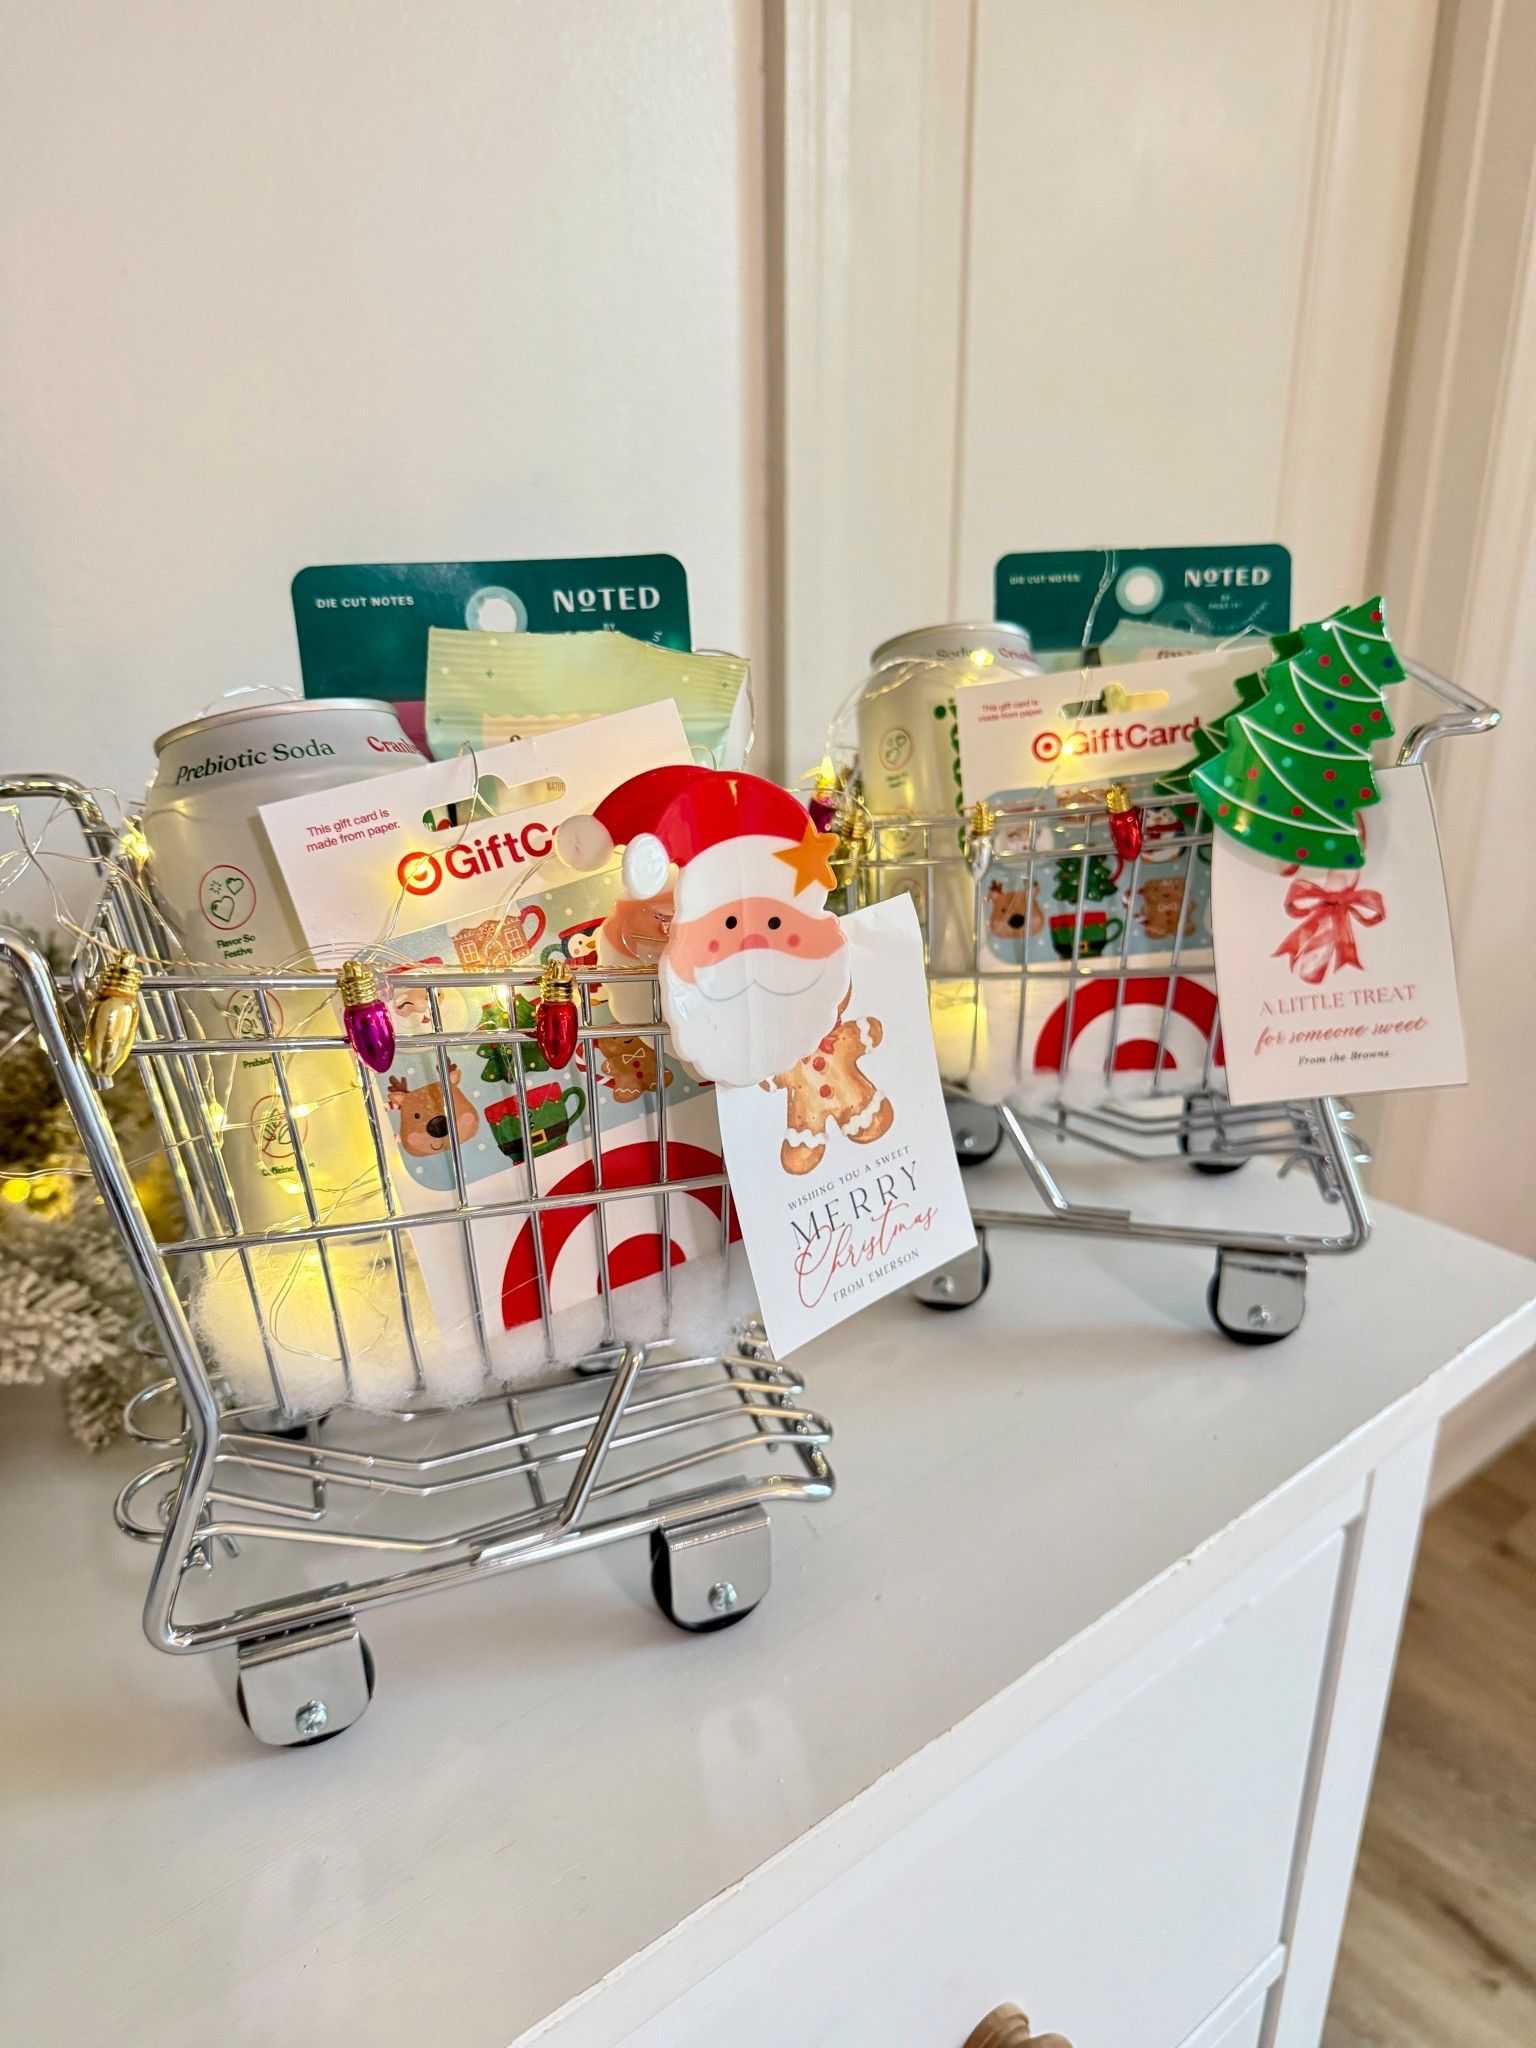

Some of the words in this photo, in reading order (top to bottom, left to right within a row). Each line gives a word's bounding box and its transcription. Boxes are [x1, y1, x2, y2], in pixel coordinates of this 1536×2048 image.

[1185, 567, 1271, 587] NOTED
[316, 599, 338, 608] DIE
[341, 598, 367, 607] CUT
[371, 596, 414, 606] NOTES
[553, 587, 660, 613] NOTED
[176, 749, 267, 785] Prebiotic
[273, 739, 336, 762] Soda
[306, 824, 332, 837] This
[333, 818, 352, 833] gift
[353, 810, 378, 826] card
[379, 808, 390, 820] is
[306, 837, 338, 852] made
[339, 829, 366, 844] from
[368, 820, 401, 841] paper.
[445, 822, 560, 879] GiftC
[217, 937, 242, 949] Flavor
[243, 933, 256, 942] So
[224, 947, 253, 959] Festive
[1259, 1001, 1273, 1017] A
[1278, 991, 1345, 1015] LITTLE
[1349, 984, 1416, 1006] TREAT
[1254, 1026, 1286, 1056] for
[1289, 1023, 1368, 1044] someone
[1372, 1015, 1429, 1036] sweet
[1298, 1055, 1326, 1066] From
[1329, 1053, 1346, 1063] the
[1350, 1050, 1389, 1060] Browns
[787, 1182, 835, 1211] WISHING
[838, 1169, 860, 1185] YOU
[864, 1164, 871, 1173] A
[875, 1145, 911, 1167] SWEET
[790, 1161, 917, 1250] MERRY
[794, 1199, 938, 1308] Christmas
[833, 1278, 864, 1302] FROM
[869, 1248, 920, 1282] EMERSON
